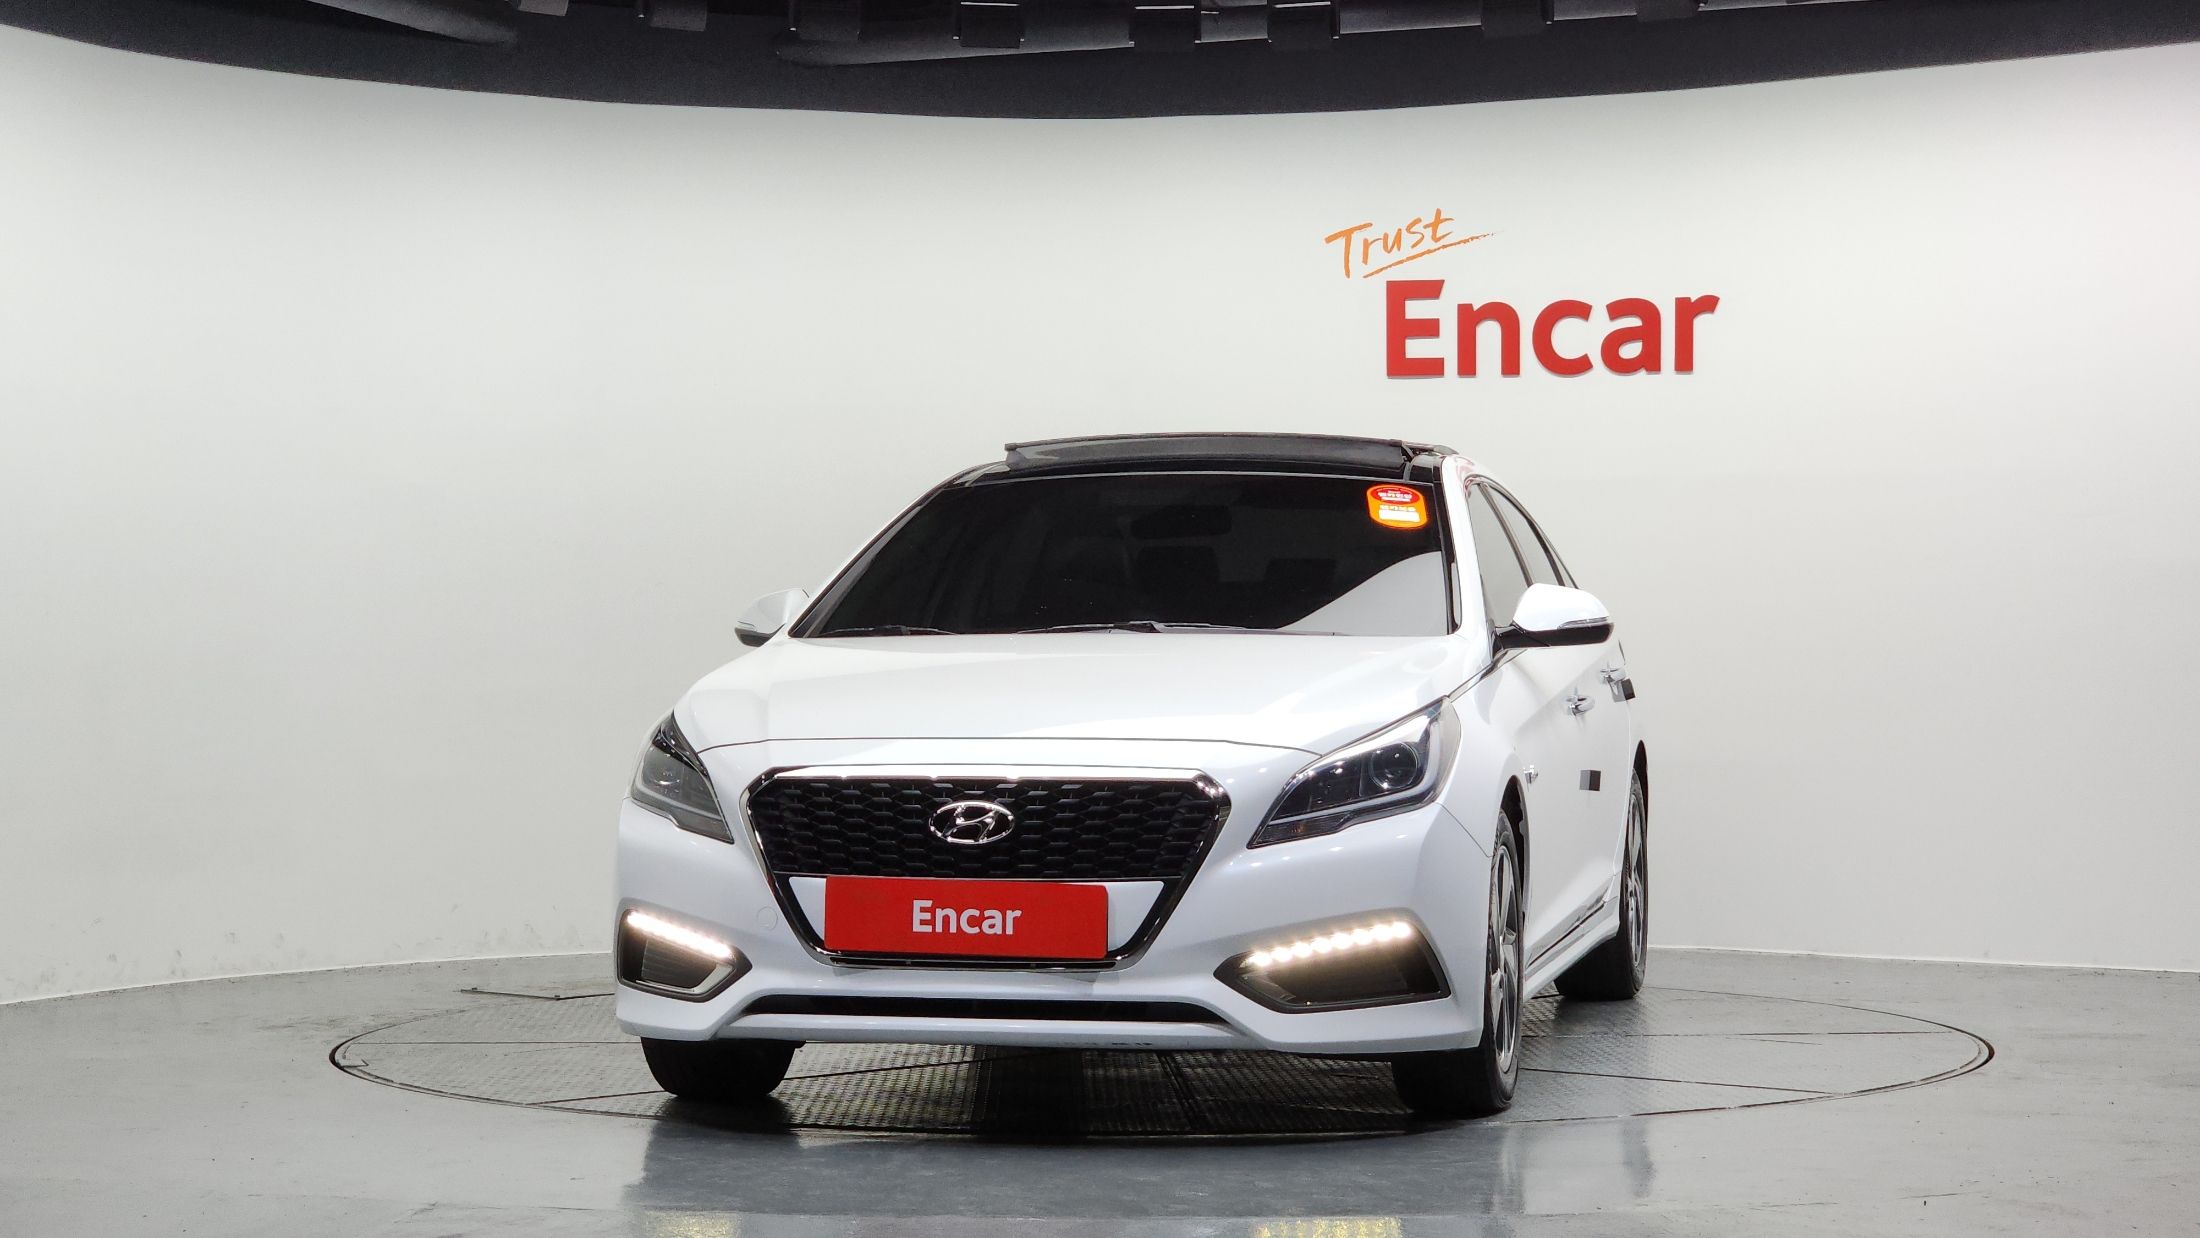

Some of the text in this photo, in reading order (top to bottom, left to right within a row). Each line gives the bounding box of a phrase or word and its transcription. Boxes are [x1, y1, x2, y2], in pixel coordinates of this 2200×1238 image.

[1324, 207, 1454, 278] Trust
[1386, 279, 1720, 378] Encar
[911, 899, 1023, 936] Encar
